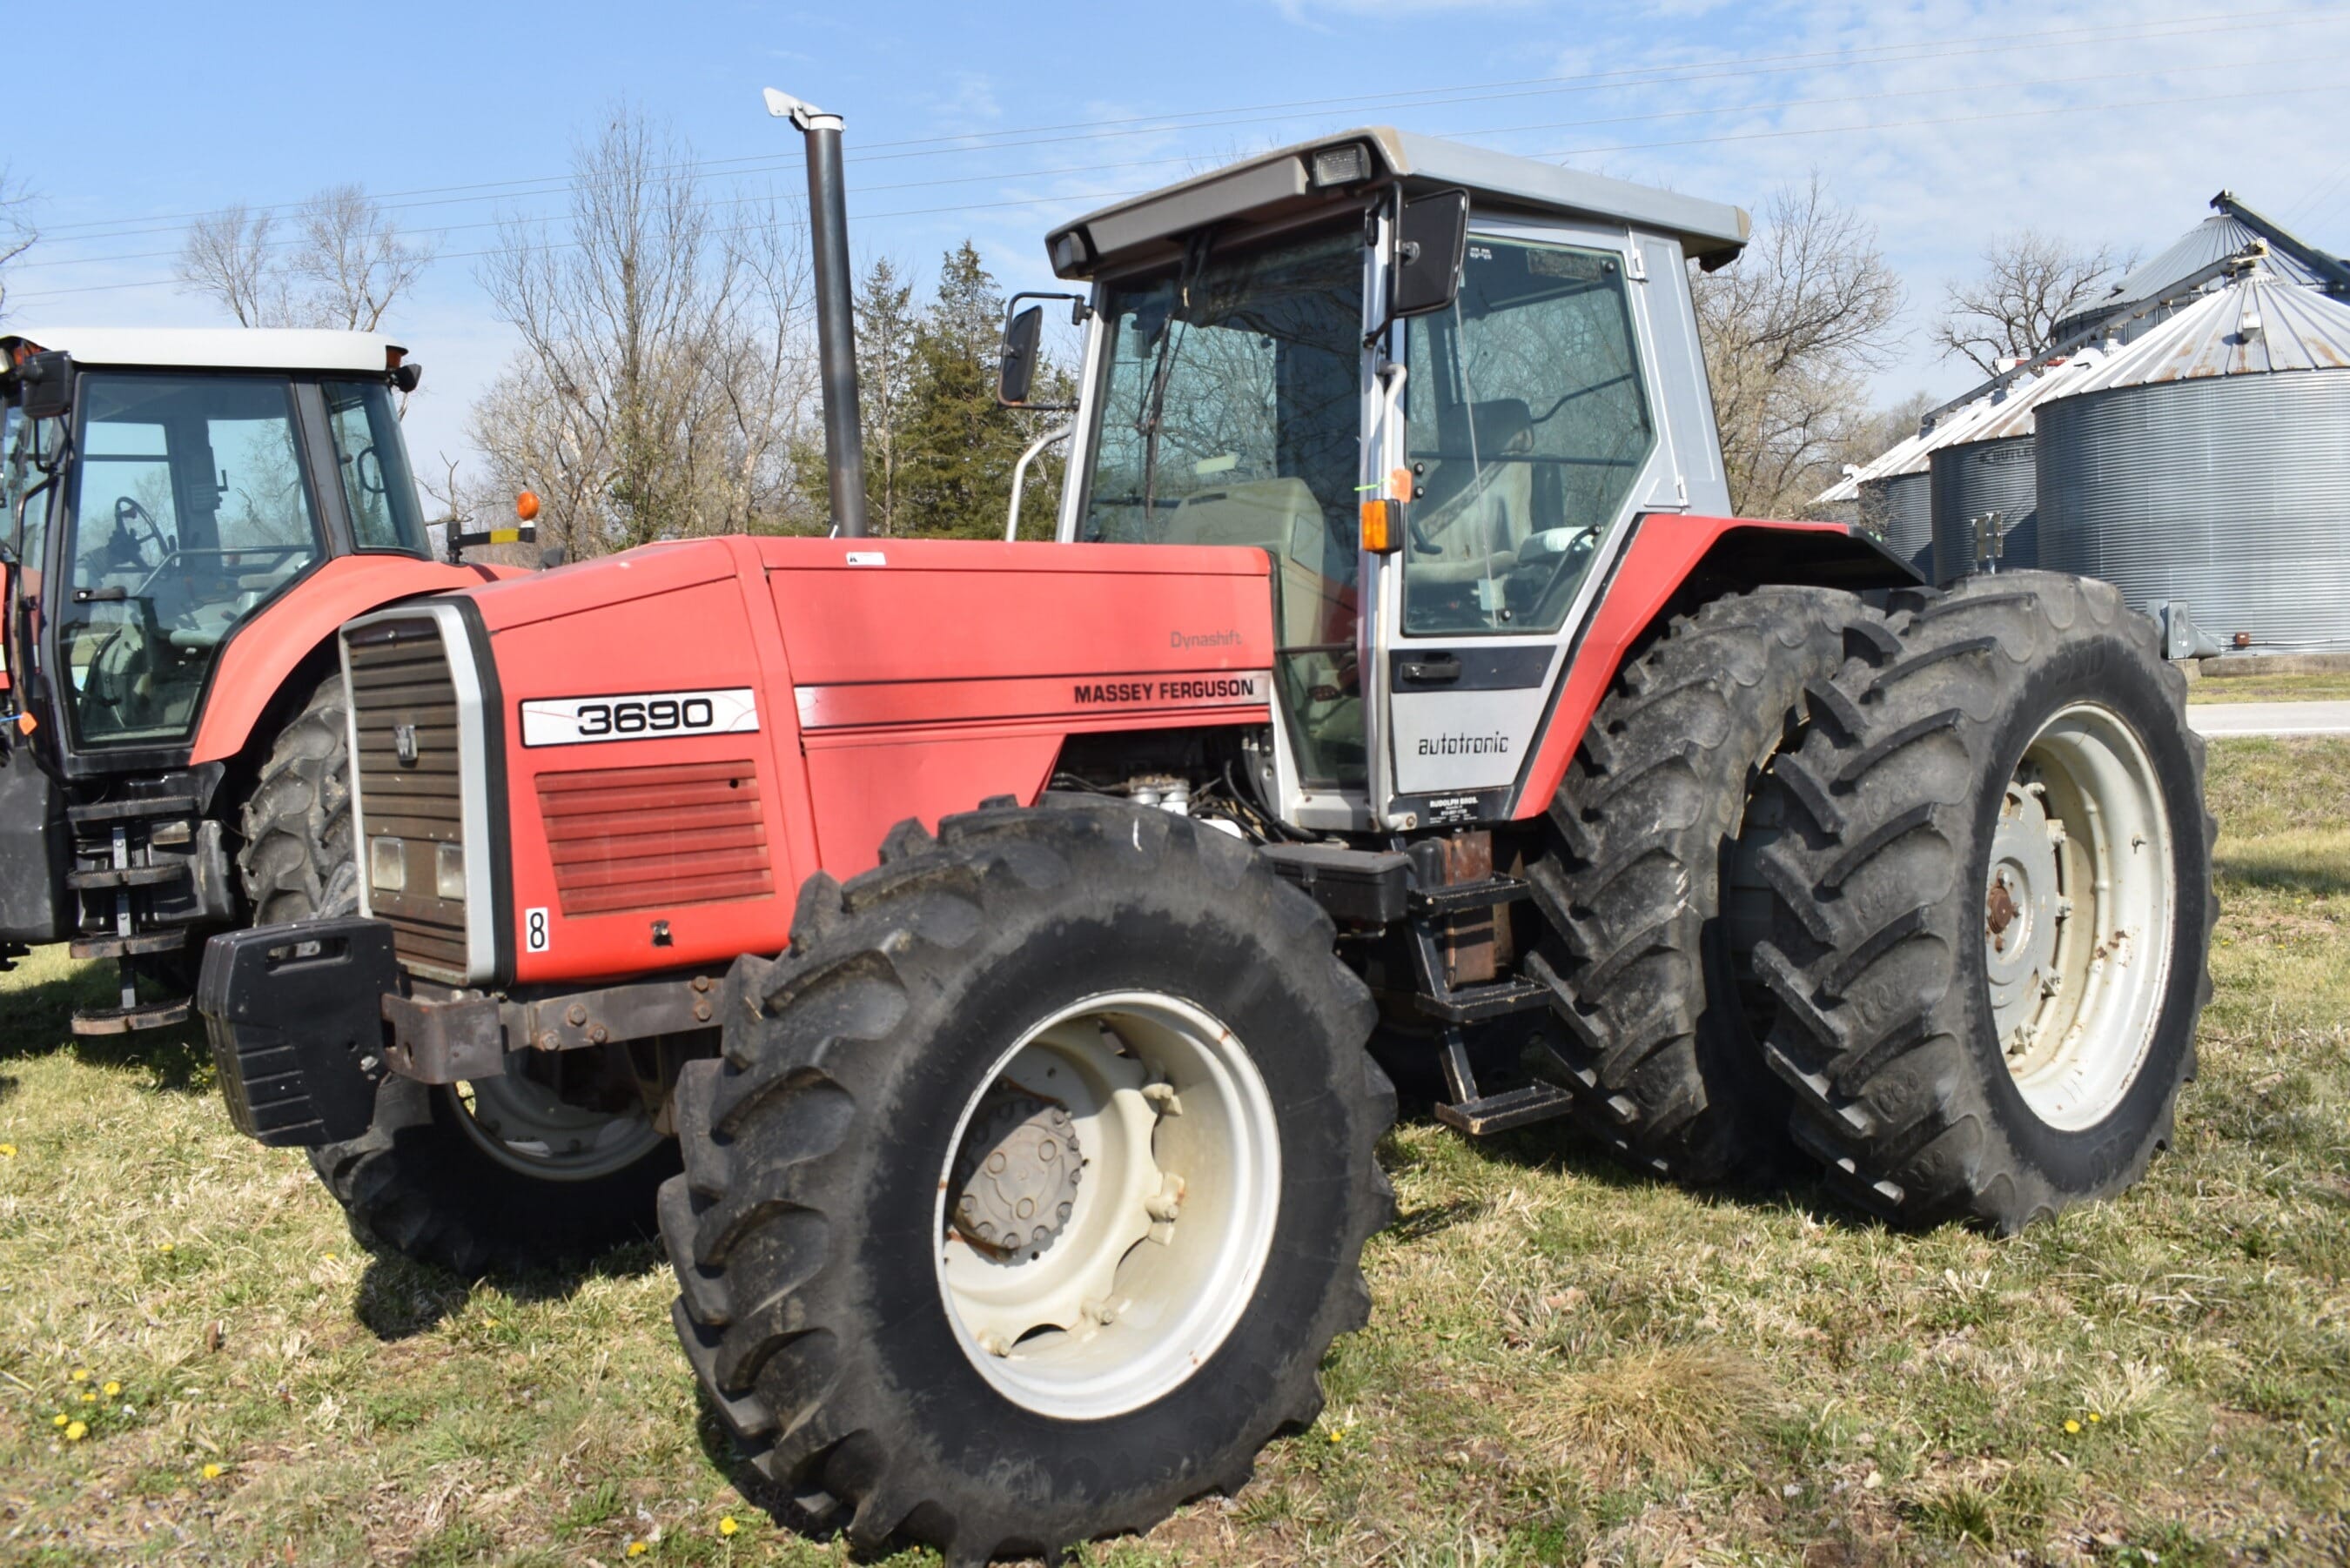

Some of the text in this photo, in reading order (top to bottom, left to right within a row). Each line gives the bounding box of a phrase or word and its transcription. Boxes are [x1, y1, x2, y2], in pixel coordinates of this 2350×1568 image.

[1170, 629, 1243, 652] Dynashift
[1074, 679, 1254, 703] MASSEY FERGUSON
[577, 698, 714, 735] 3690
[1419, 731, 1509, 755] autotronic
[1429, 798, 1460, 808] RUDOLPH
[529, 911, 546, 949] 8
